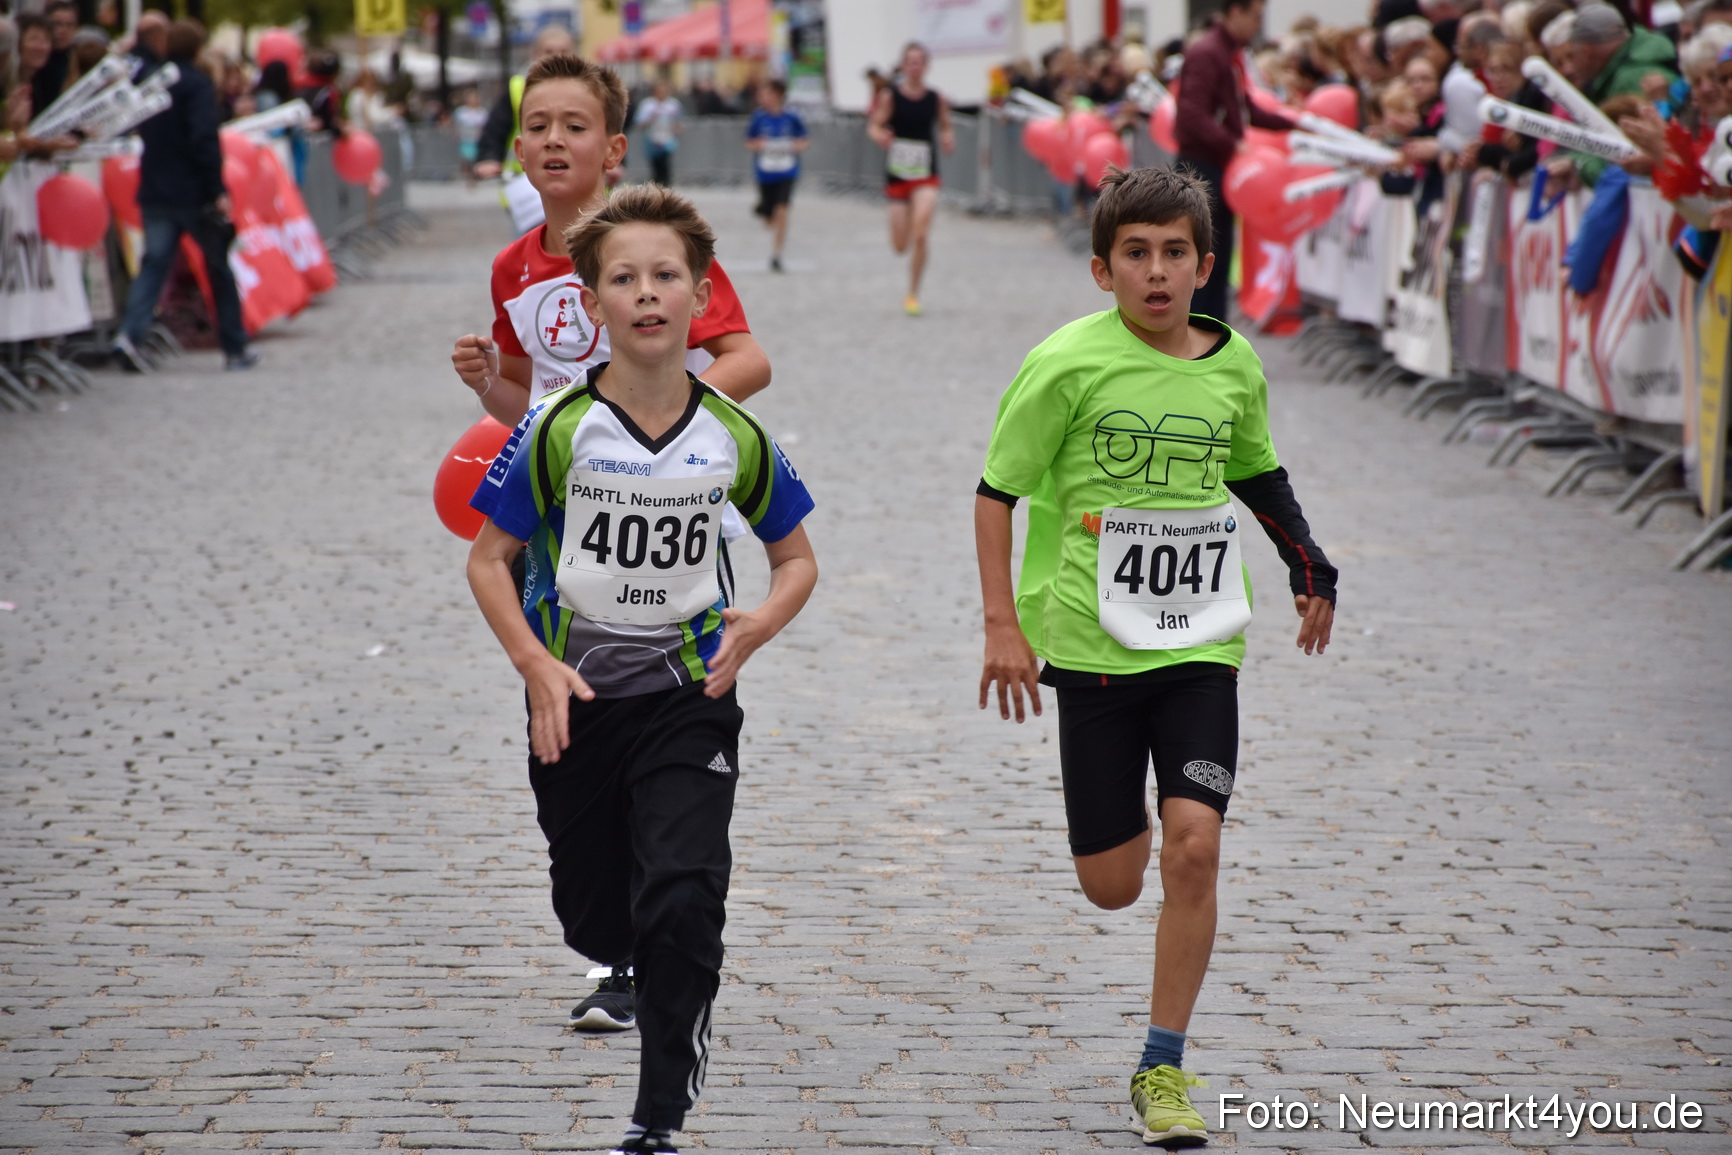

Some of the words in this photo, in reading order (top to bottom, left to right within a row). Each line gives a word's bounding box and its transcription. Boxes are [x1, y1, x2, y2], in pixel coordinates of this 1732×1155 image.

[588, 458, 651, 476] TEAM
[571, 484, 626, 505] PARTL
[630, 492, 703, 507] Neumarkt
[1127, 486, 1143, 495] und
[1105, 521, 1158, 536] PARTL
[1161, 521, 1220, 537] Neumarkt
[580, 511, 710, 570] 4036
[567, 556, 574, 566] J
[1114, 540, 1228, 597] 4047
[616, 584, 667, 605] Jens
[1105, 591, 1110, 600] J
[1156, 610, 1190, 630] Jan
